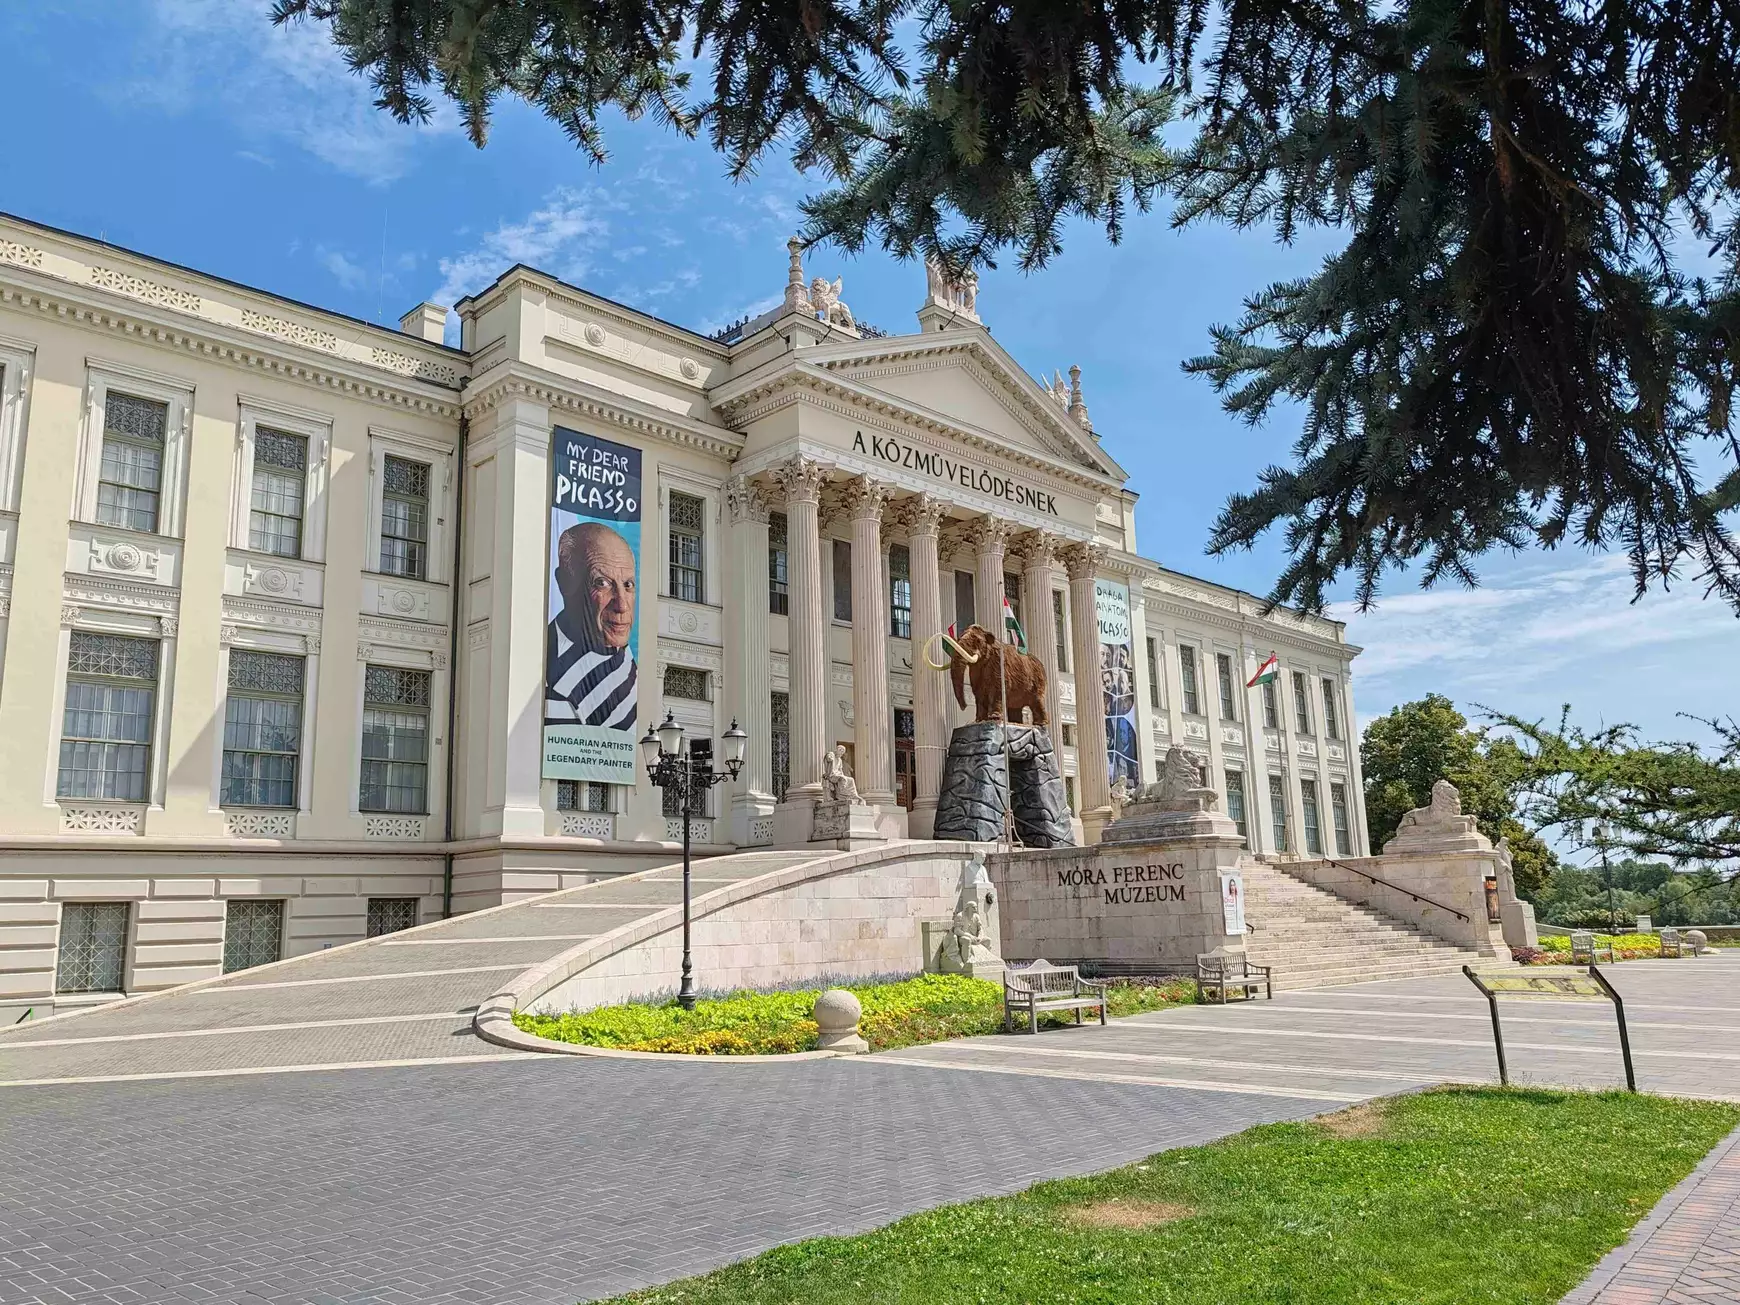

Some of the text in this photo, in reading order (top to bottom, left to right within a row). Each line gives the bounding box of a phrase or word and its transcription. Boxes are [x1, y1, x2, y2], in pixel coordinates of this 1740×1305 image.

[566, 441, 629, 472] MY DEAR
[569, 459, 626, 487] FRIEND
[852, 430, 1059, 516] A KÖZMŰVELŐDÉSNEK
[547, 736, 634, 752] HUNGARIAN ARTISTS
[546, 754, 633, 769] LEGENDARY PAINTER
[1057, 863, 1185, 887] MÓRA FERENC
[1104, 883, 1187, 905] MÚZEUM
